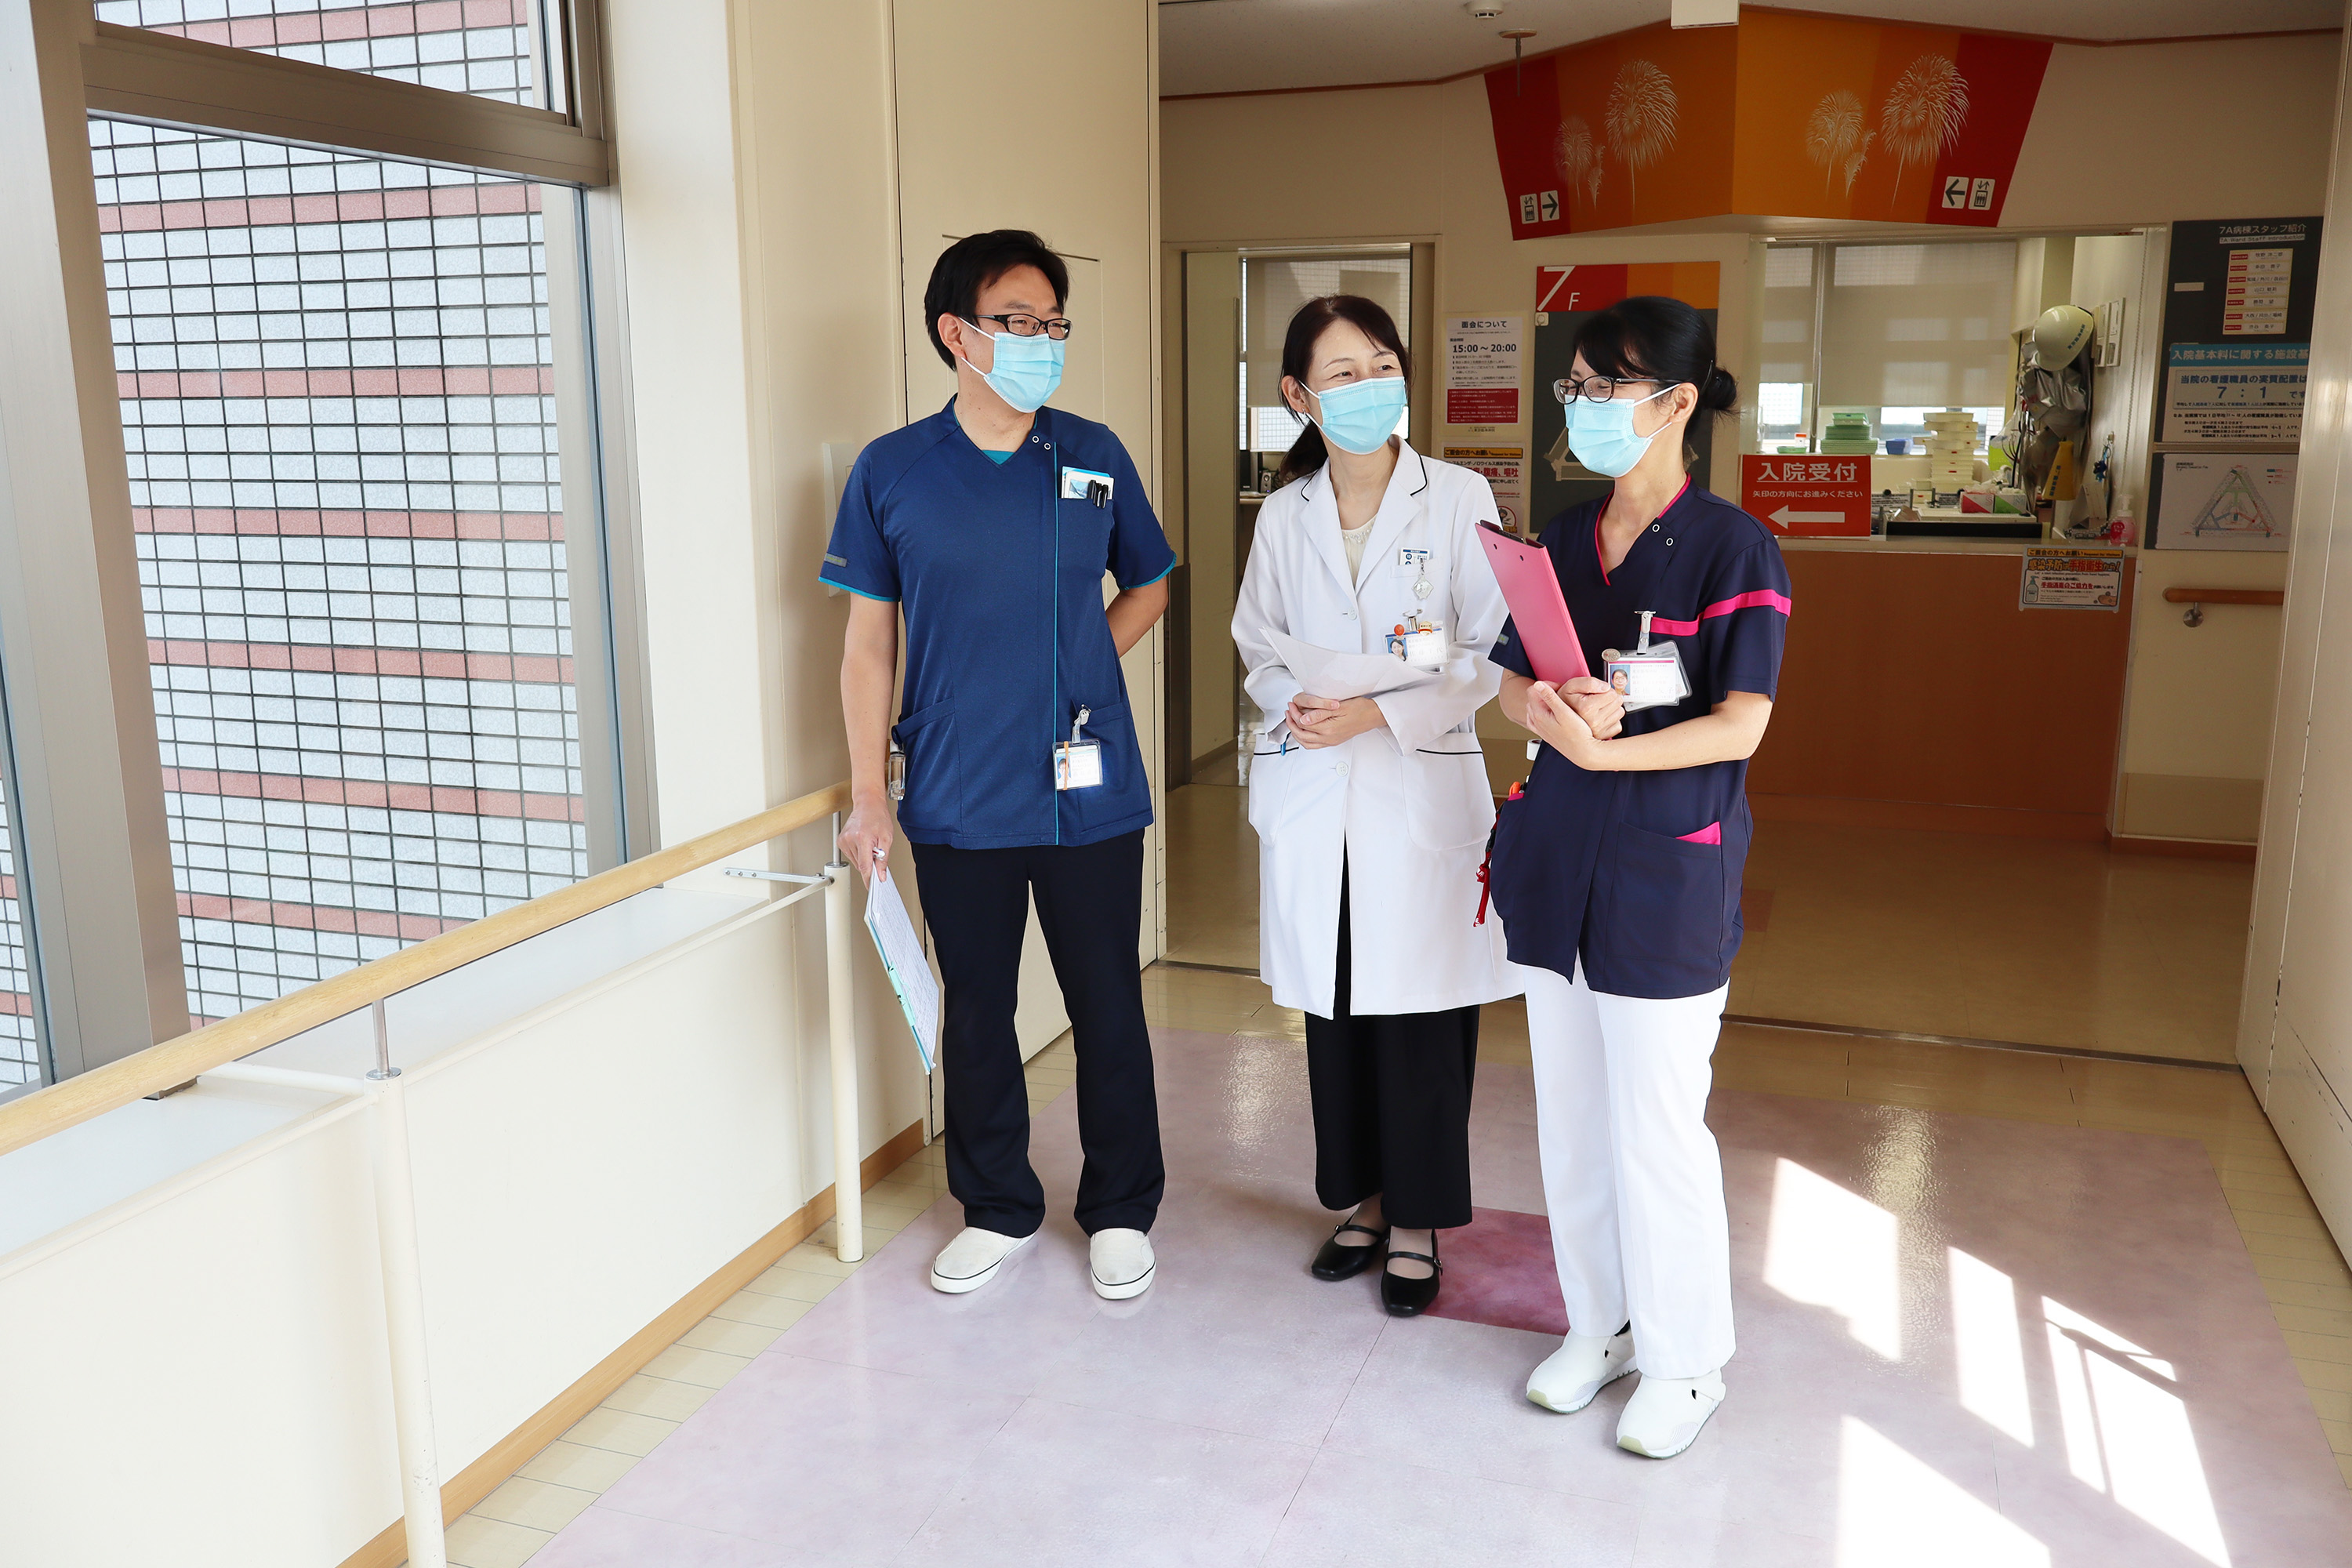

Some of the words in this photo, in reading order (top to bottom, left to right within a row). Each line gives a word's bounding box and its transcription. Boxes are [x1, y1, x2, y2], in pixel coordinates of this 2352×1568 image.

[2219, 223, 2307, 234] 7A病棟スタッフ紹介
[1490, 343, 1517, 352] 20:00
[1757, 462, 1857, 481] 入院受付
